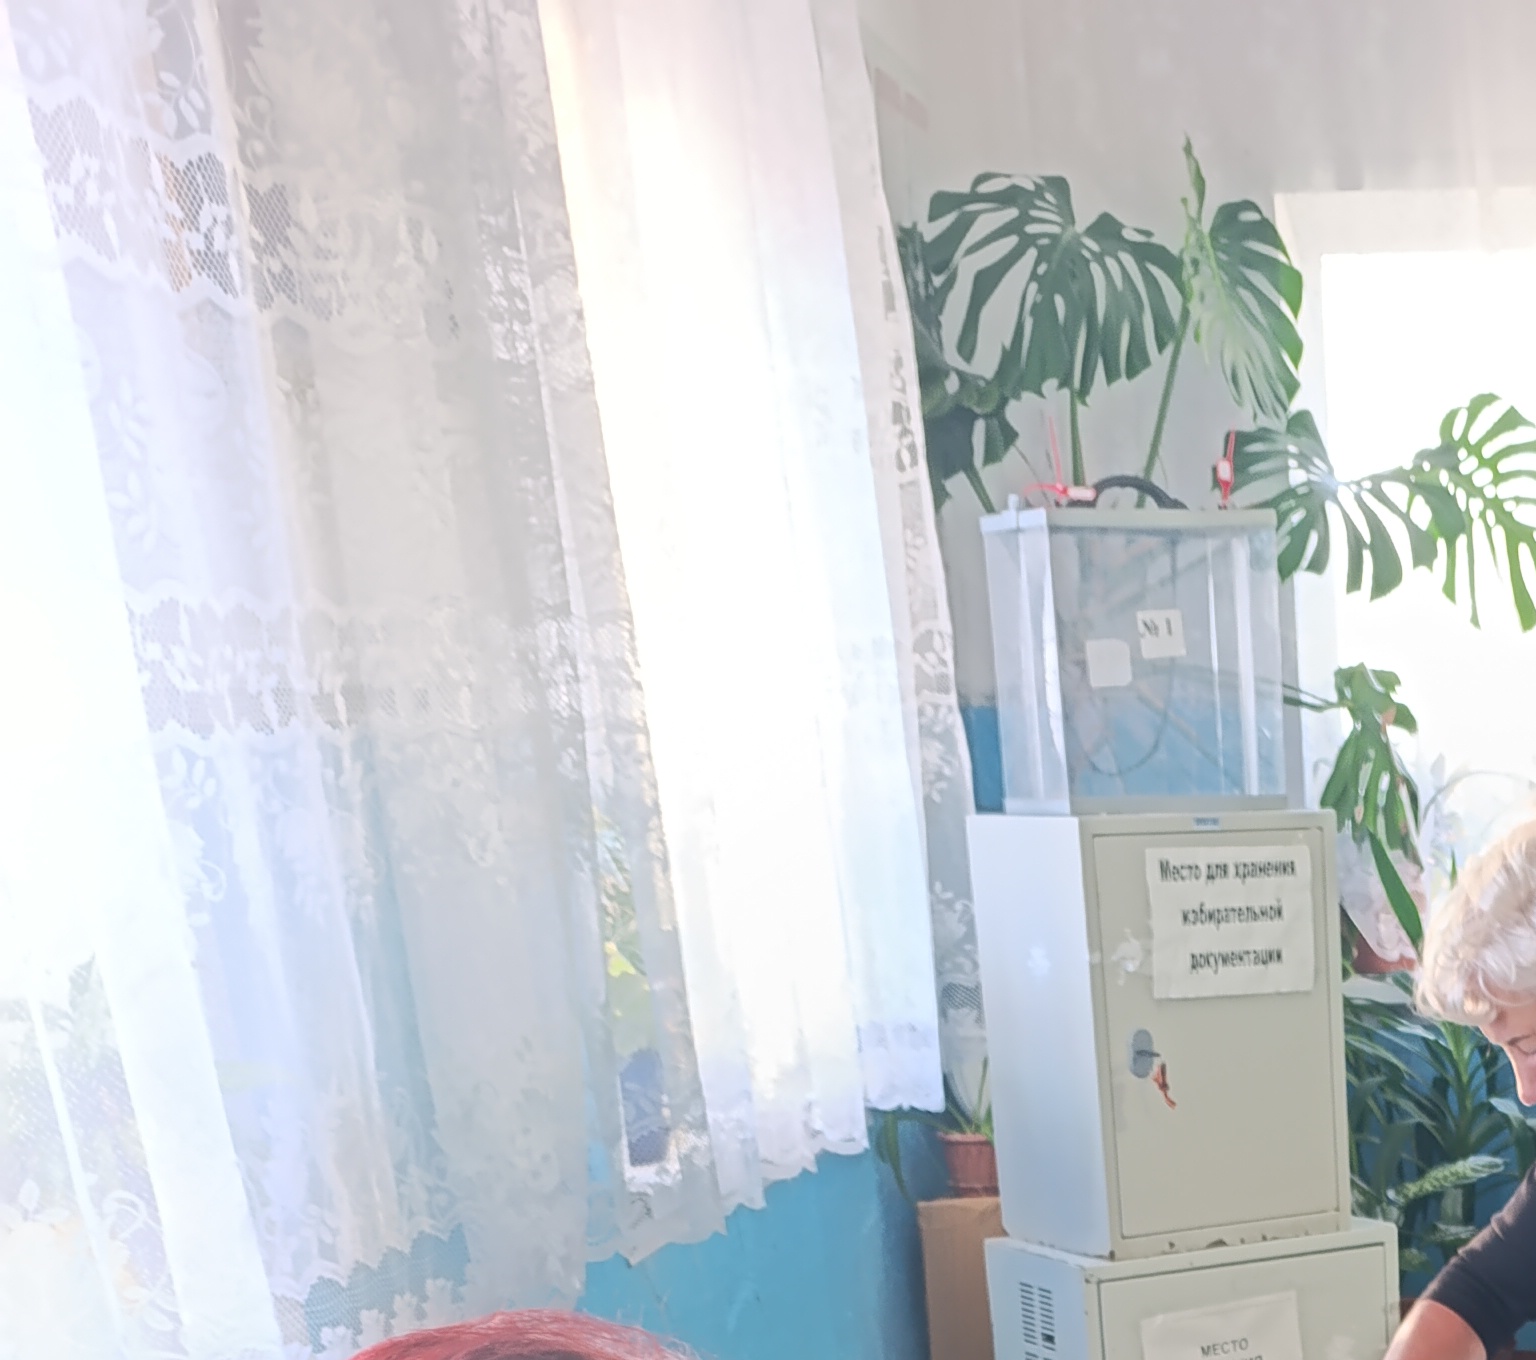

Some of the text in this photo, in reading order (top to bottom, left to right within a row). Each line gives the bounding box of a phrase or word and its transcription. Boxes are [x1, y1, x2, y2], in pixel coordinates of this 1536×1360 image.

[1165, 617, 1173, 637] 1
[1159, 858, 1297, 885] Место для хранения
[1182, 897, 1284, 931] избирательной
[1189, 948, 1283, 975] документации
[1200, 1337, 1249, 1357] МЕСТО
